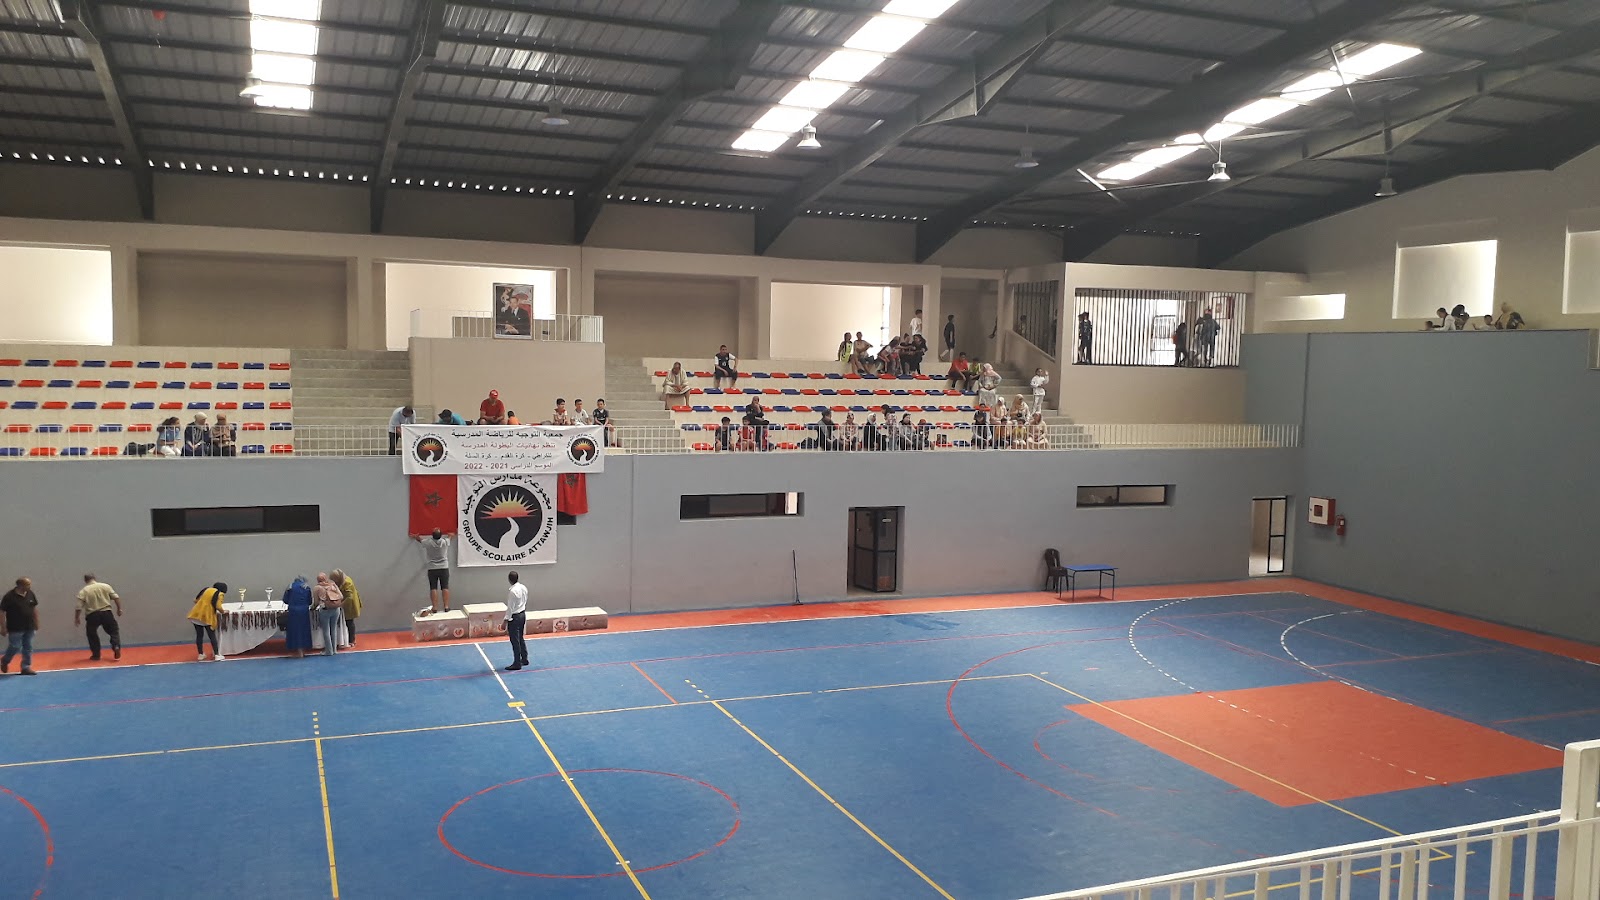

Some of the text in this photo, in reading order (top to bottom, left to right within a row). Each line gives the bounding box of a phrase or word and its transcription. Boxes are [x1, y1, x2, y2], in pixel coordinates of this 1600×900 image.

[451, 429, 563, 439] جمعية التوجيه للرياضة المدرسية
[490, 441, 514, 450] البطولة
[464, 451, 480, 459] السلة
[481, 452, 492, 460] كرة
[501, 452, 514, 460] القدم
[515, 452, 525, 460] كرة
[464, 462, 483, 470] 2022
[490, 462, 508, 470] 2021
[534, 462, 554, 470] الموسم
[461, 473, 552, 515] مجموعة مدارس التوجيه
[462, 517, 554, 562] GROUPE SCOLAIRE ATTAWJIH
